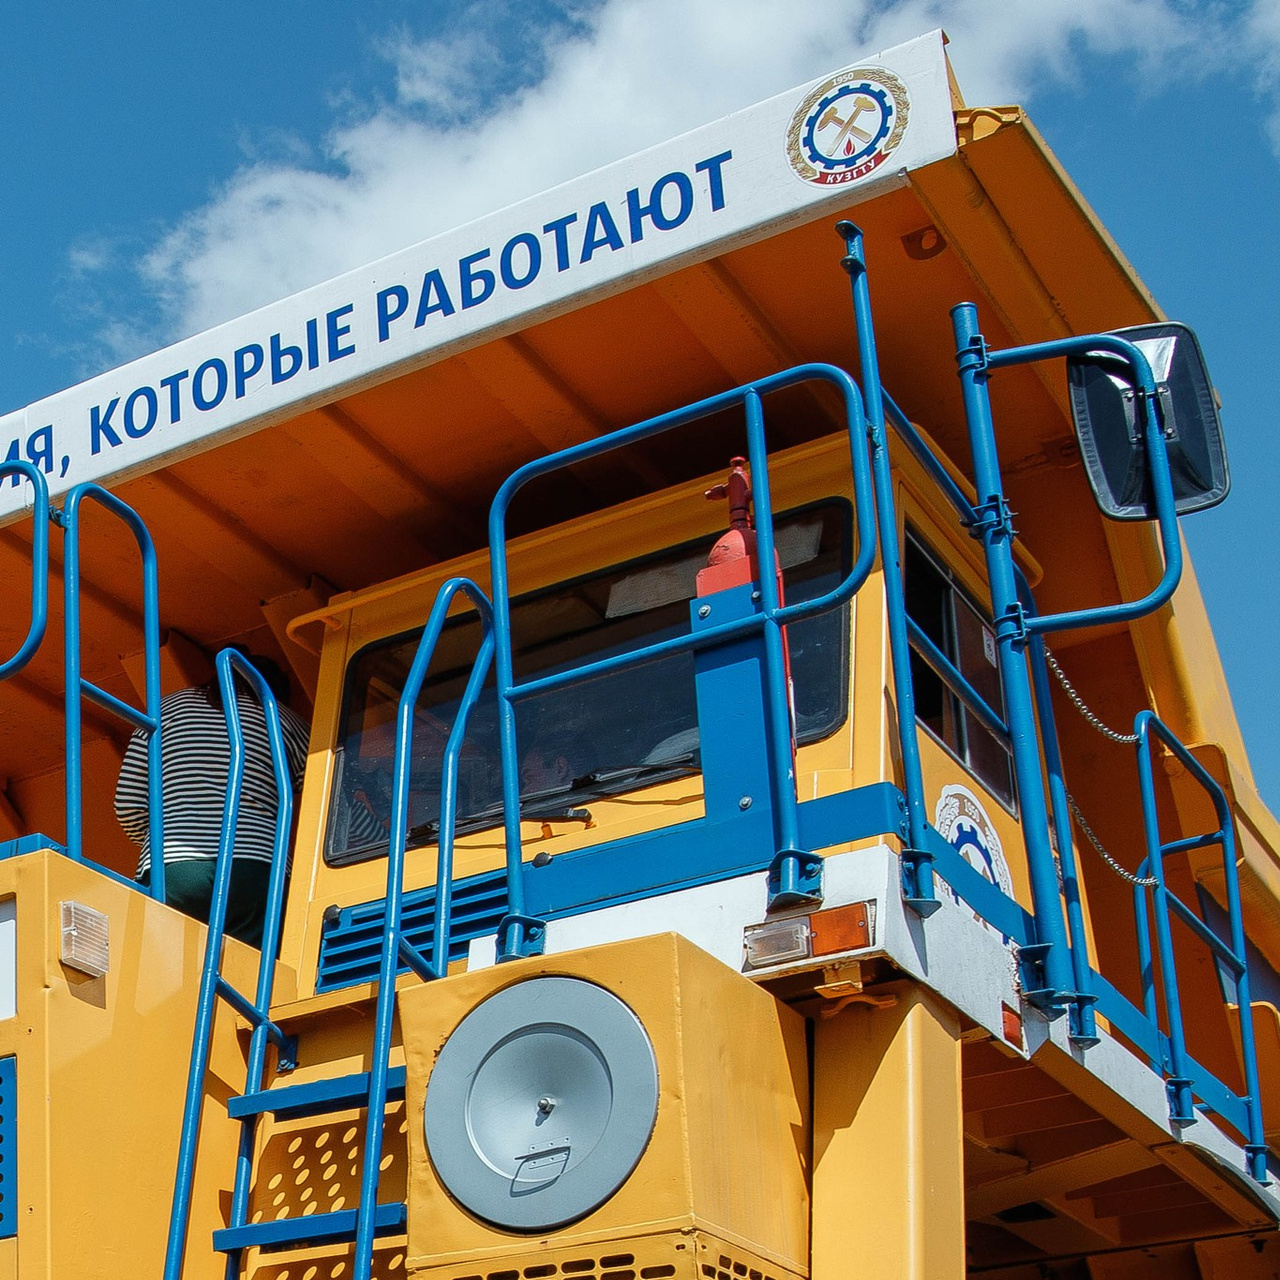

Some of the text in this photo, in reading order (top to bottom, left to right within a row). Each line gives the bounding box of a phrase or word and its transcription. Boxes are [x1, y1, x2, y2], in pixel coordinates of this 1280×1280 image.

[832, 72, 855, 86] 1950
[825, 158, 877, 184] КУЗГТУ
[89, 303, 357, 456] КОТОРЫЕ
[375, 149, 733, 343] РАБОТАЮТ
